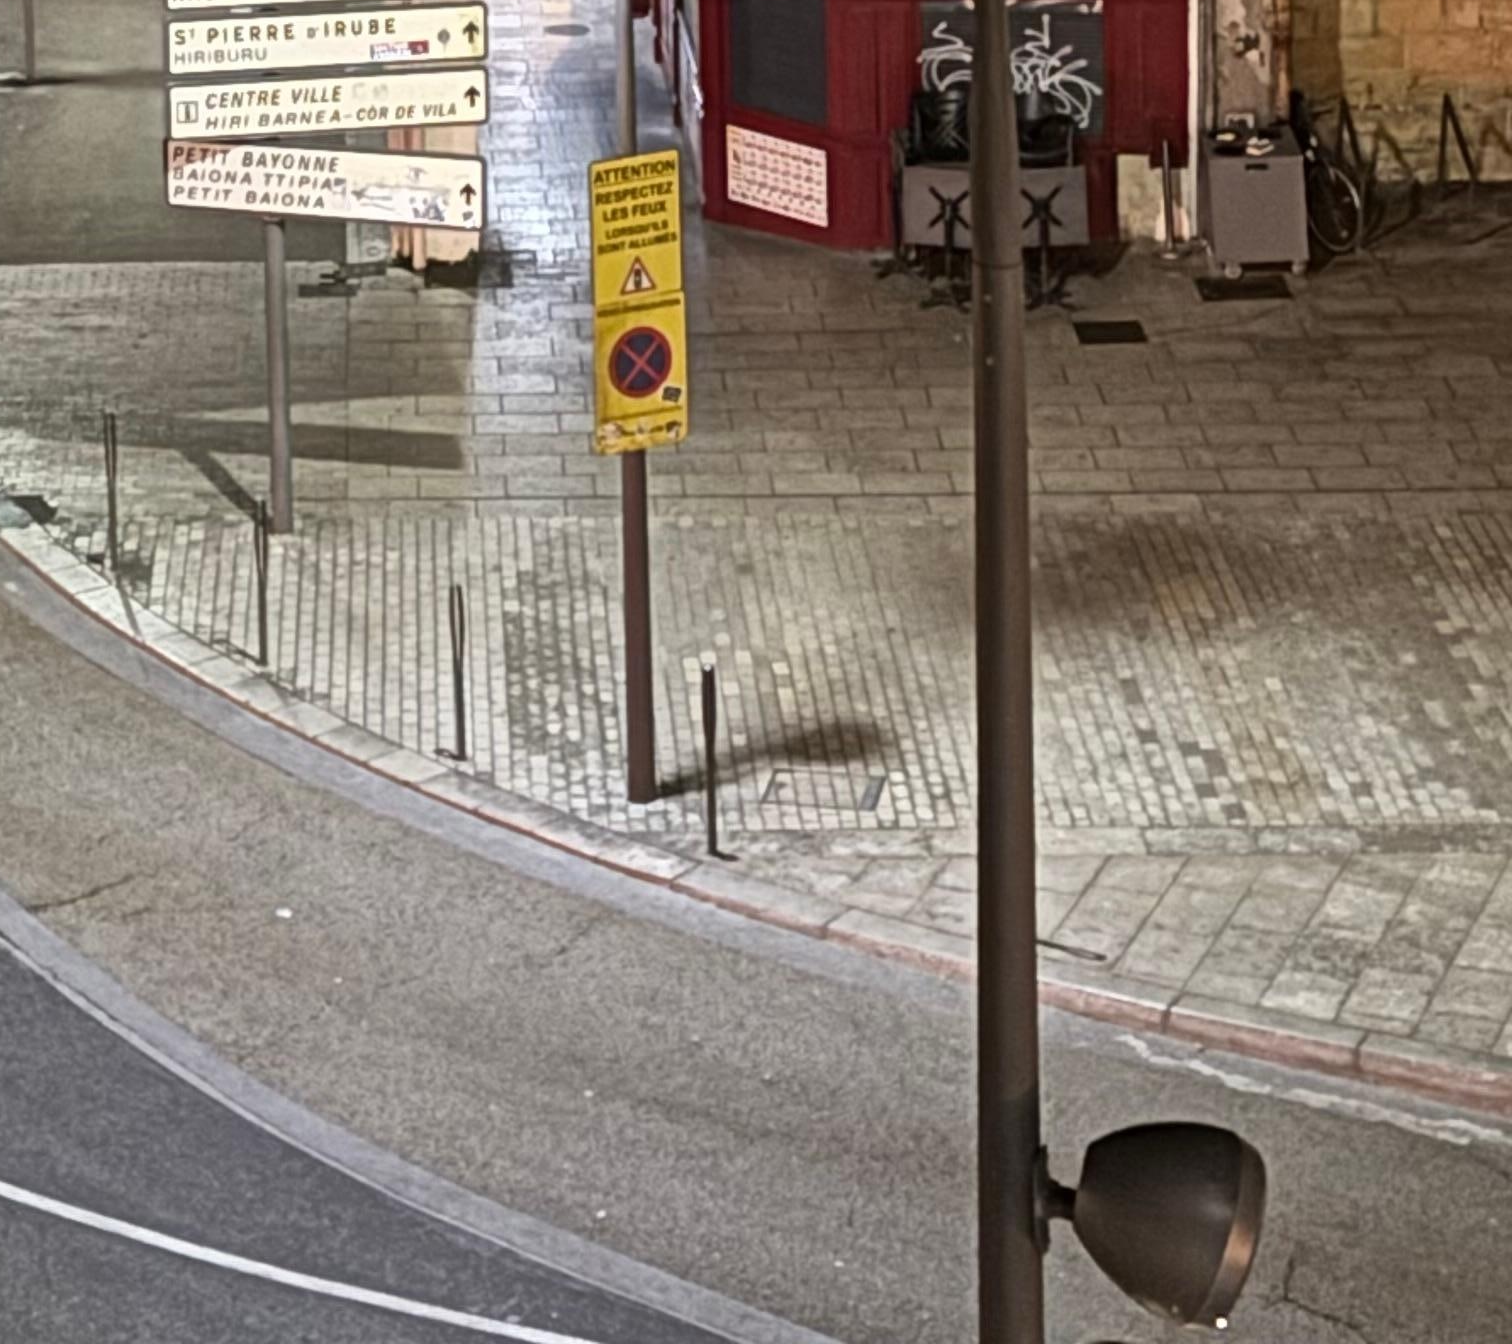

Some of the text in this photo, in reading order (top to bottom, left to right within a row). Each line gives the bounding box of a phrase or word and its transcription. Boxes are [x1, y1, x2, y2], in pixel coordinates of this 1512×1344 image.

[206, 23, 296, 45] PIERRE
[174, 47, 268, 65] HIRIBURU
[205, 88, 281, 110] CENTRE
[291, 85, 343, 105] VILLE
[205, 114, 250, 131] HIRI
[394, 104, 416, 119] DE
[423, 102, 458, 117] VILA
[173, 146, 340, 173] PETIT BAYONNE
[594, 159, 676, 184] ATTENTION
[173, 167, 336, 190] BAIONA TTIPIA
[173, 185, 326, 209] PETIT BAIONA
[595, 180, 673, 206] RESPECTEZ
[602, 200, 667, 223] LES FEUX
[597, 240, 626, 255] SONT
